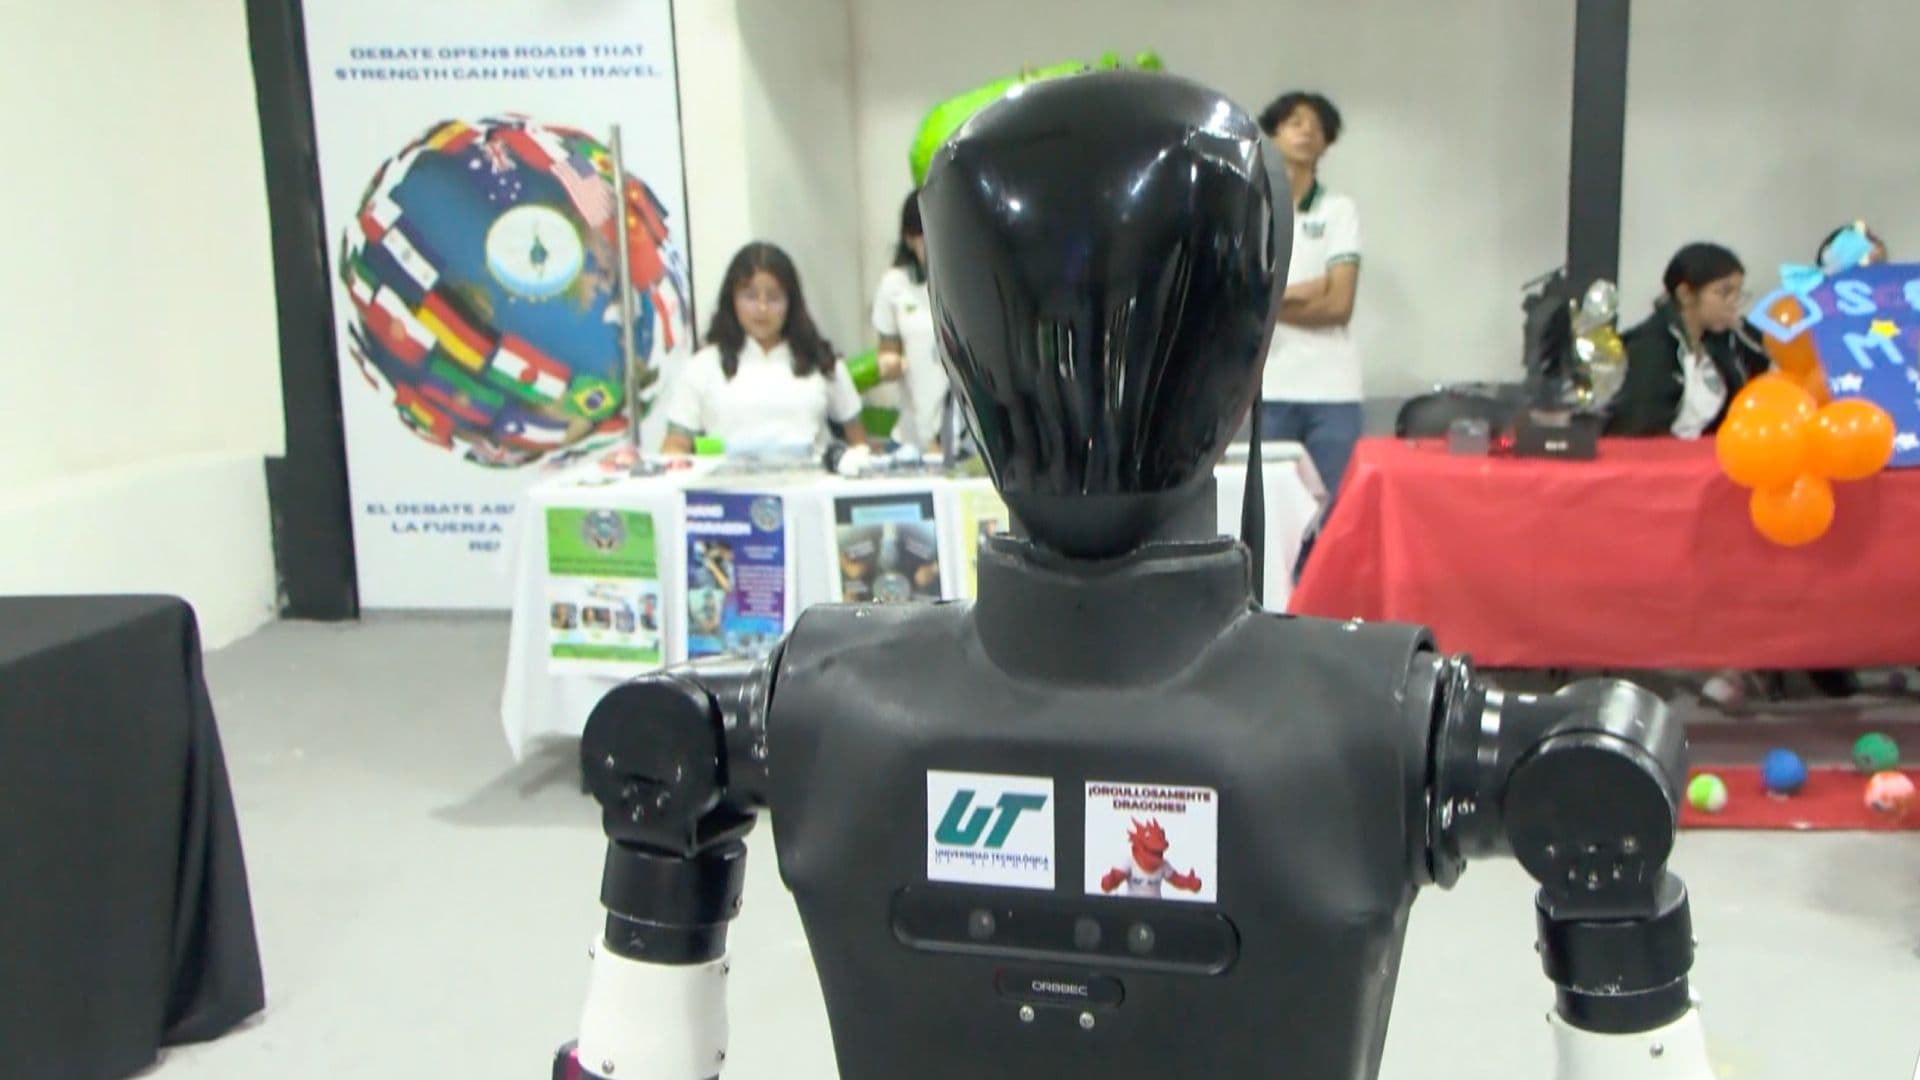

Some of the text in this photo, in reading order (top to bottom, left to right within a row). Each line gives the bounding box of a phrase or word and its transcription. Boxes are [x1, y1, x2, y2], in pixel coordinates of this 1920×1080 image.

[349, 43, 644, 60] DEBATE OPENS ROADS THAT
[334, 67, 448, 81] STRENGTH
[452, 66, 498, 80] CAN
[501, 65, 574, 79] NEVER
[366, 503, 387, 515] EL
[395, 503, 474, 515] DEBATE
[391, 521, 503, 533] LA FUERZA
[934, 789, 1049, 849] UT
